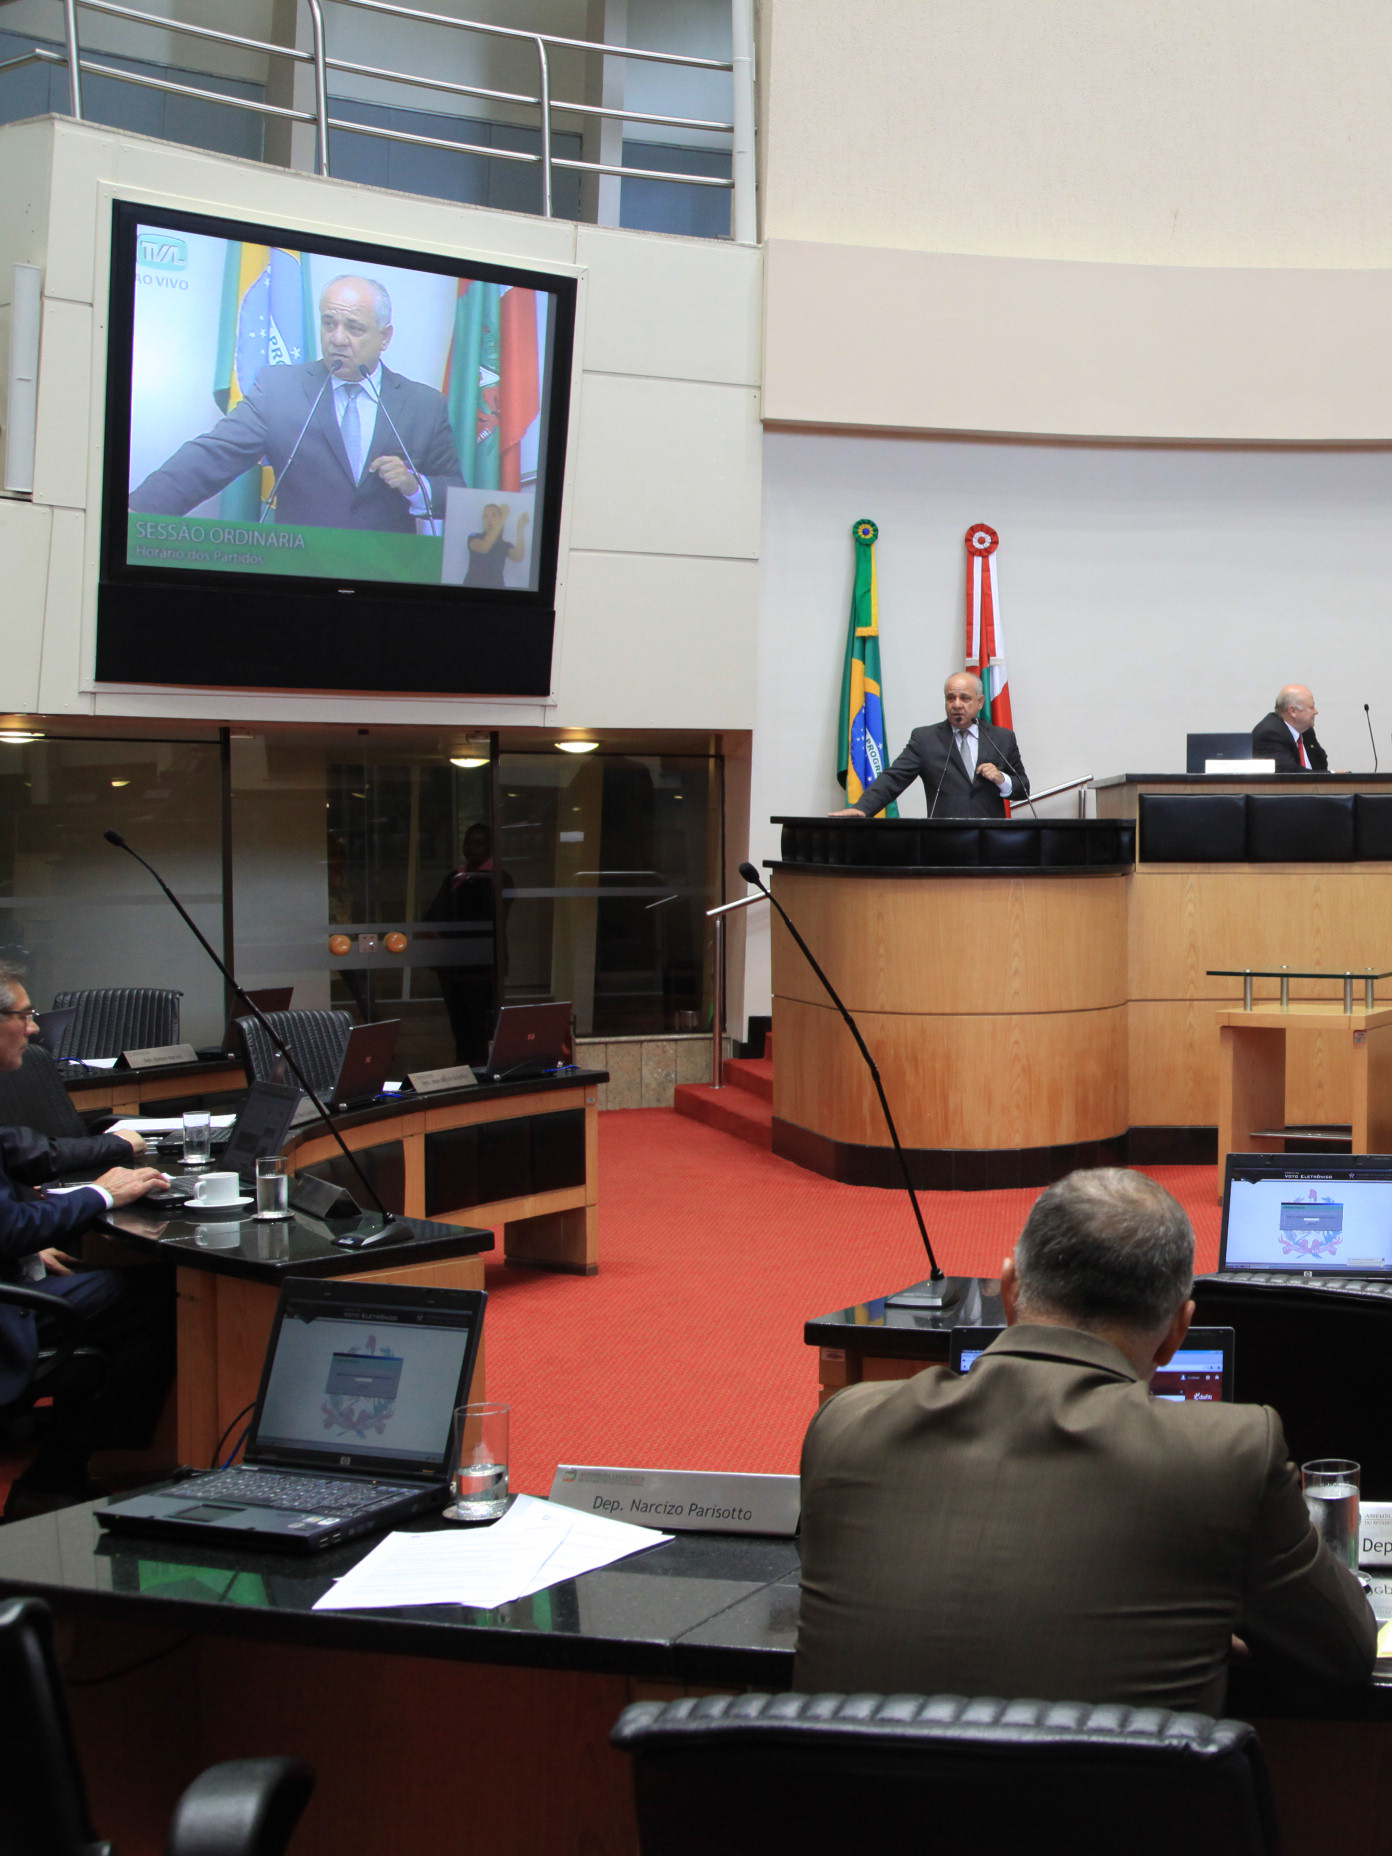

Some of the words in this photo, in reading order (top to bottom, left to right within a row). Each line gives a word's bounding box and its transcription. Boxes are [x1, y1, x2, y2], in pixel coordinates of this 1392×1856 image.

[156, 276, 189, 290] VIVO
[136, 521, 205, 542] SESSÃO
[209, 527, 305, 548] ORDINÁRIA
[188, 549, 210, 561] dos
[214, 551, 264, 565] Partidos
[592, 1496, 623, 1514] Dep.
[630, 1499, 684, 1515] Narcizo
[687, 1503, 752, 1521] Parisotto
